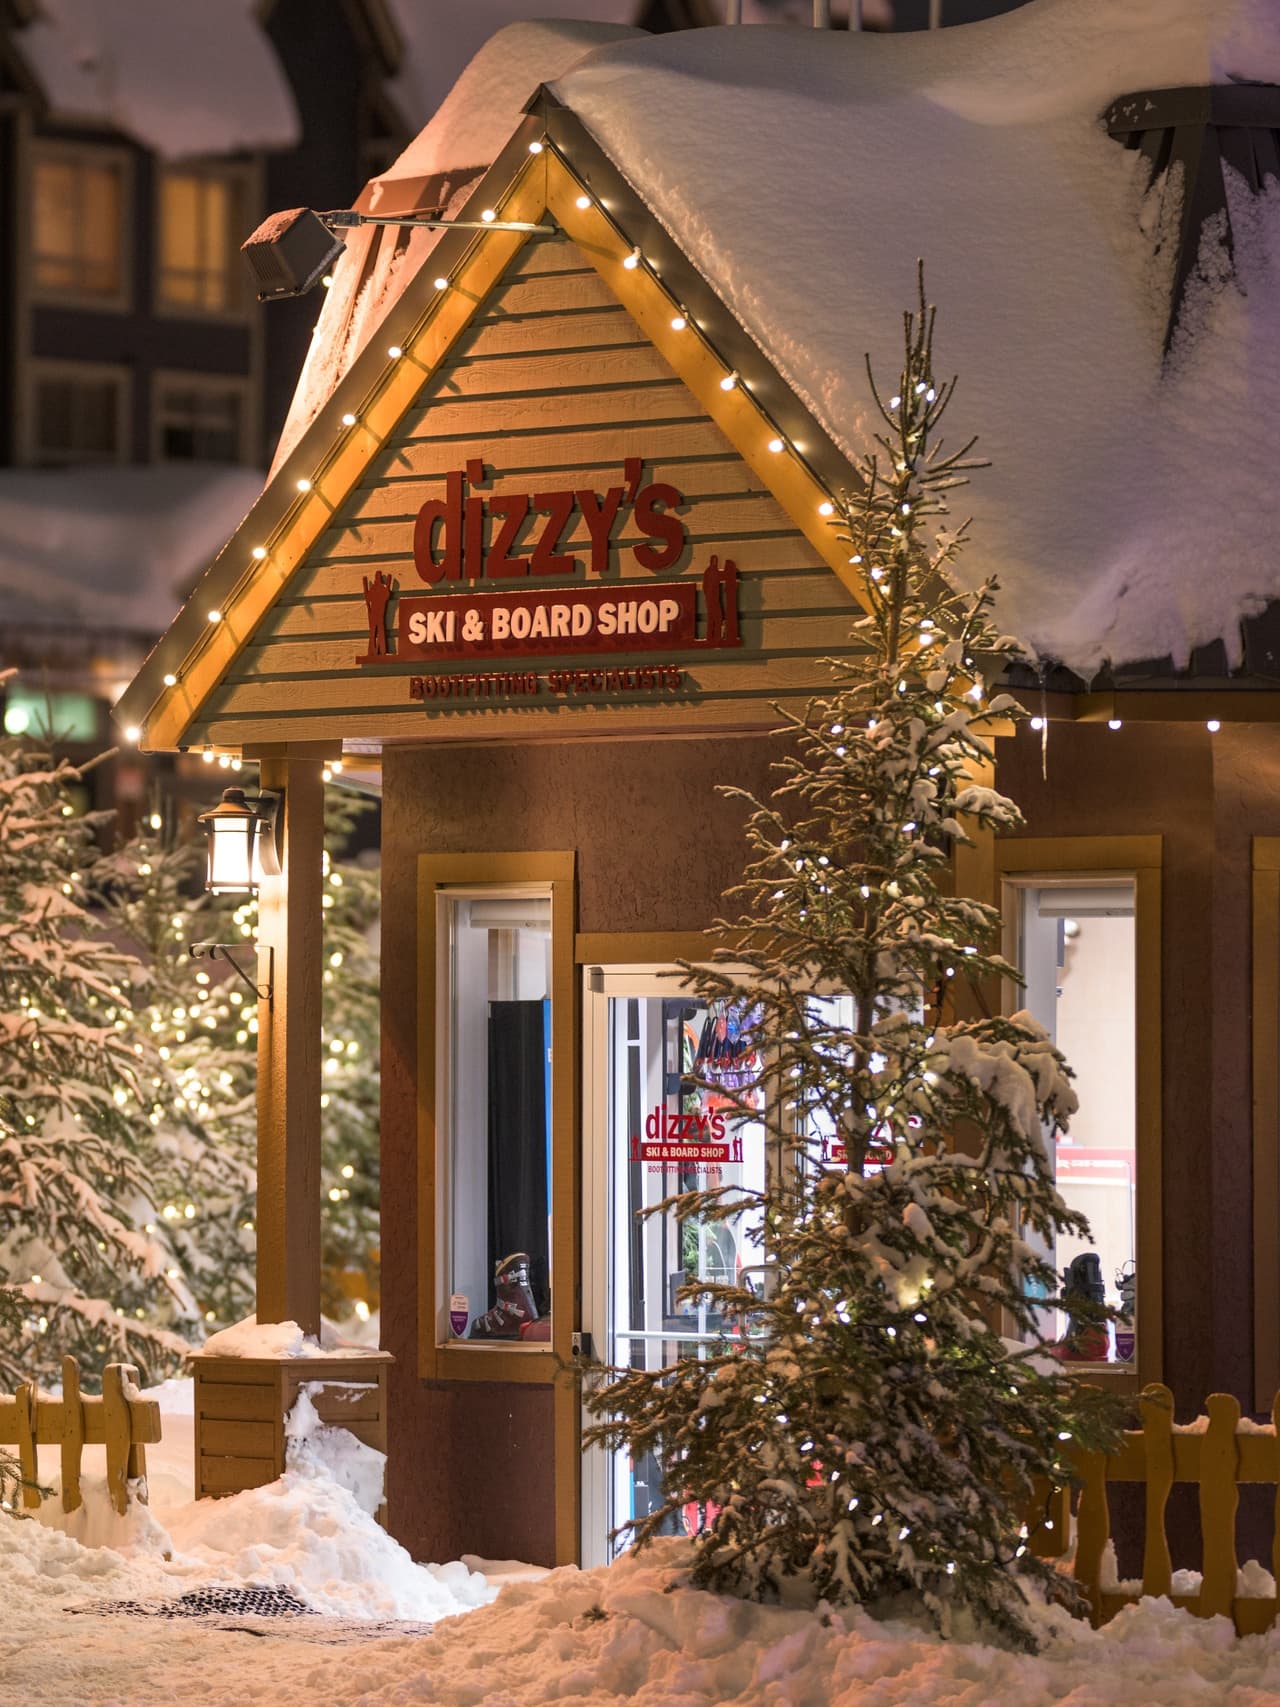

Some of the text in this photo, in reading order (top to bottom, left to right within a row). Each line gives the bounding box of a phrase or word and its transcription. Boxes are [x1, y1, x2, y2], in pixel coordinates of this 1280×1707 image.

[413, 457, 686, 585] dizzy's
[408, 599, 681, 645] SKI & BOARD SHOP
[408, 663, 683, 700] BOOTFITTING SPECIALISTS
[645, 1103, 726, 1140] dizzy's
[646, 1146, 725, 1158] SKI & BOARD SHOP
